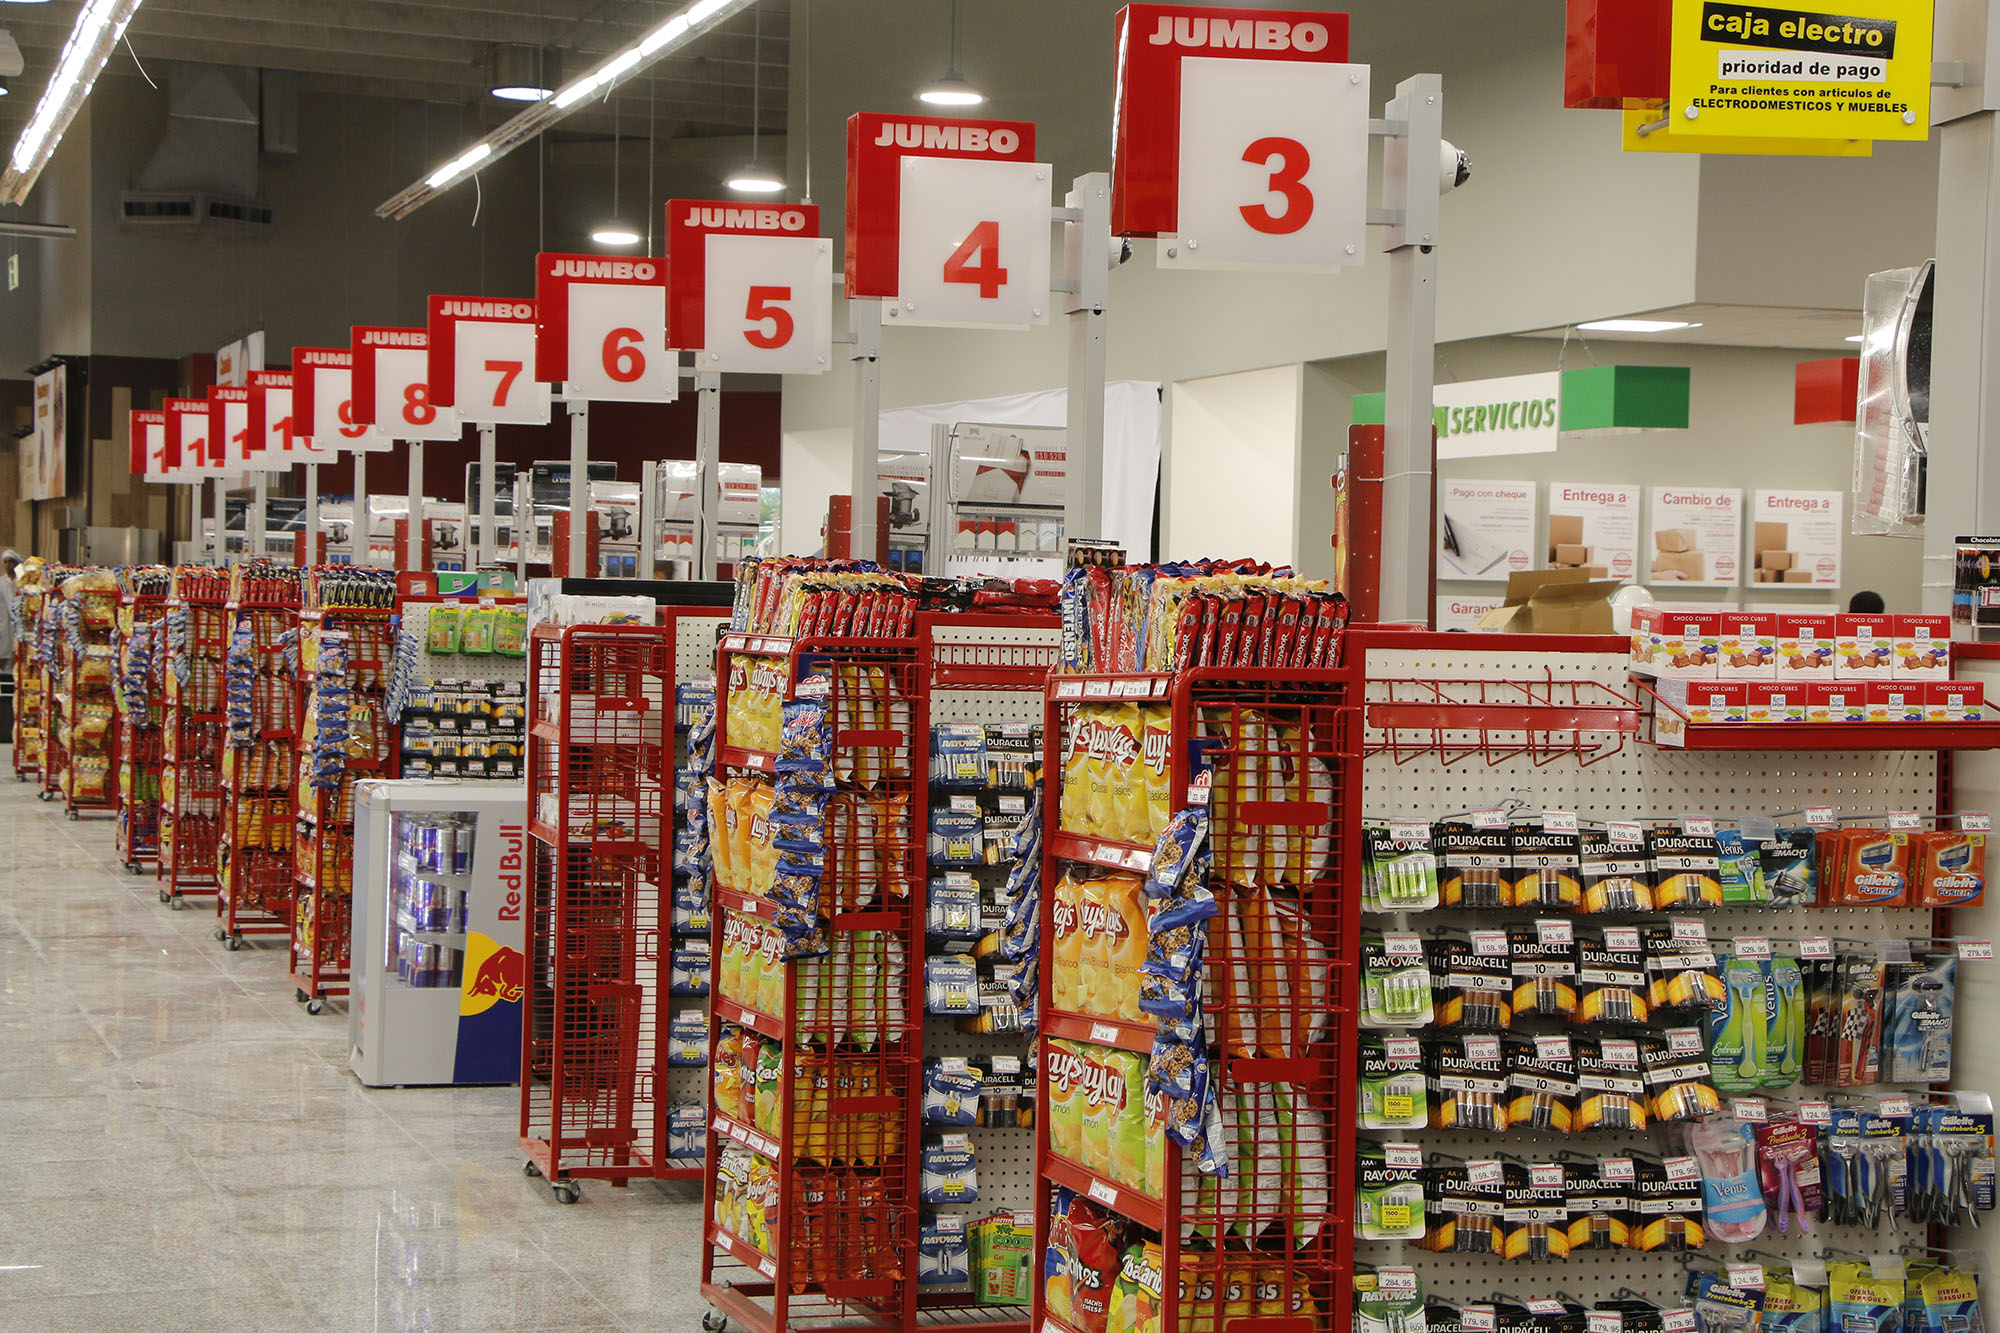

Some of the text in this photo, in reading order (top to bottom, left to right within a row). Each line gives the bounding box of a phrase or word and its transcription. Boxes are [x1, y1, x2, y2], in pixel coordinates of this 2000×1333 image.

[1149, 16, 1329, 52] JUMBO
[1708, 12, 1883, 47] caja electro
[1722, 60, 1881, 79] prioridad de pago
[1710, 85, 1891, 98] Para clientes con articulos de
[1693, 98, 1907, 112] ELECTRODOMESTICOS Y MUEBLES
[875, 122, 1019, 153] JUMBO
[1239, 136, 1314, 234] 3
[684, 208, 805, 230] JUMBO
[943, 221, 1008, 298] 4
[551, 260, 656, 280] JUMBO
[440, 301, 532, 318] JUMBO
[743, 286, 794, 349] 5
[362, 331, 428, 346] JUMB
[302, 352, 351, 365] JUM
[602, 327, 646, 382] 6
[255, 374, 292, 386] JUM
[484, 360, 523, 406] 7
[402, 383, 436, 425] 8
[1451, 398, 1556, 435] SERVICIOS
[1453, 489, 1527, 499] Pago con cheque
[1563, 489, 1626, 504] Entrega a
[1663, 493, 1731, 506] Cambio de
[1768, 496, 1829, 511] Entrega a
[1063, 599, 1075, 661] INTENSO
[987, 739, 1029, 747] DURACELL
[1374, 841, 1429, 850] RAYOVAC
[1449, 836, 1506, 846] DURACELL
[1515, 837, 1573, 846] DURACELL
[1657, 838, 1713, 848] DURACELL
[1760, 842, 1793, 850] Gillette
[1582, 844, 1639, 854] DURACELL
[1716, 840, 1744, 854] Venus
[1470, 857, 1481, 866] 10
[1537, 857, 1548, 866] 10
[1680, 858, 1691, 867] 10
[498, 825, 523, 921] Red Bull
[1606, 863, 1617, 873] 10
[1855, 875, 1899, 886] Gillette
[1933, 878, 1977, 888] Gillette
[1513, 944, 1570, 954] DURACELL
[1369, 956, 1423, 967] RAYOVAC
[1451, 955, 1508, 968] DURACELL
[1583, 952, 1639, 964] DURACELL
[1680, 957, 1690, 966] 10
[1535, 964, 1546, 973] 10
[1472, 977, 1483, 986] 10
[1605, 973, 1616, 982] 10
[1366, 1061, 1419, 1070] RAYOVAC
[1442, 1057, 1500, 1071] DURACELL
[1518, 1055, 1575, 1074] DURACELL
[1672, 1069, 1682, 1078] 10
[1464, 1079, 1474, 1089] 10
[1536, 1079, 1547, 1089] 10
[1604, 1079, 1614, 1088] 10
[1941, 1116, 1974, 1125] Gillette
[1364, 1170, 1417, 1181] RAYOVAC
[1642, 1181, 1697, 1191] DURACELL
[1713, 1183, 1748, 1196] Venus
[1506, 1190, 1562, 1199] DURACELL
[1466, 1202, 1476, 1211] 10
[1592, 1200, 1598, 1209] 5
[1667, 1201, 1674, 1210] 5
[1528, 1210, 1539, 1219] 10
[922, 1235, 963, 1244] RAYOVAC
